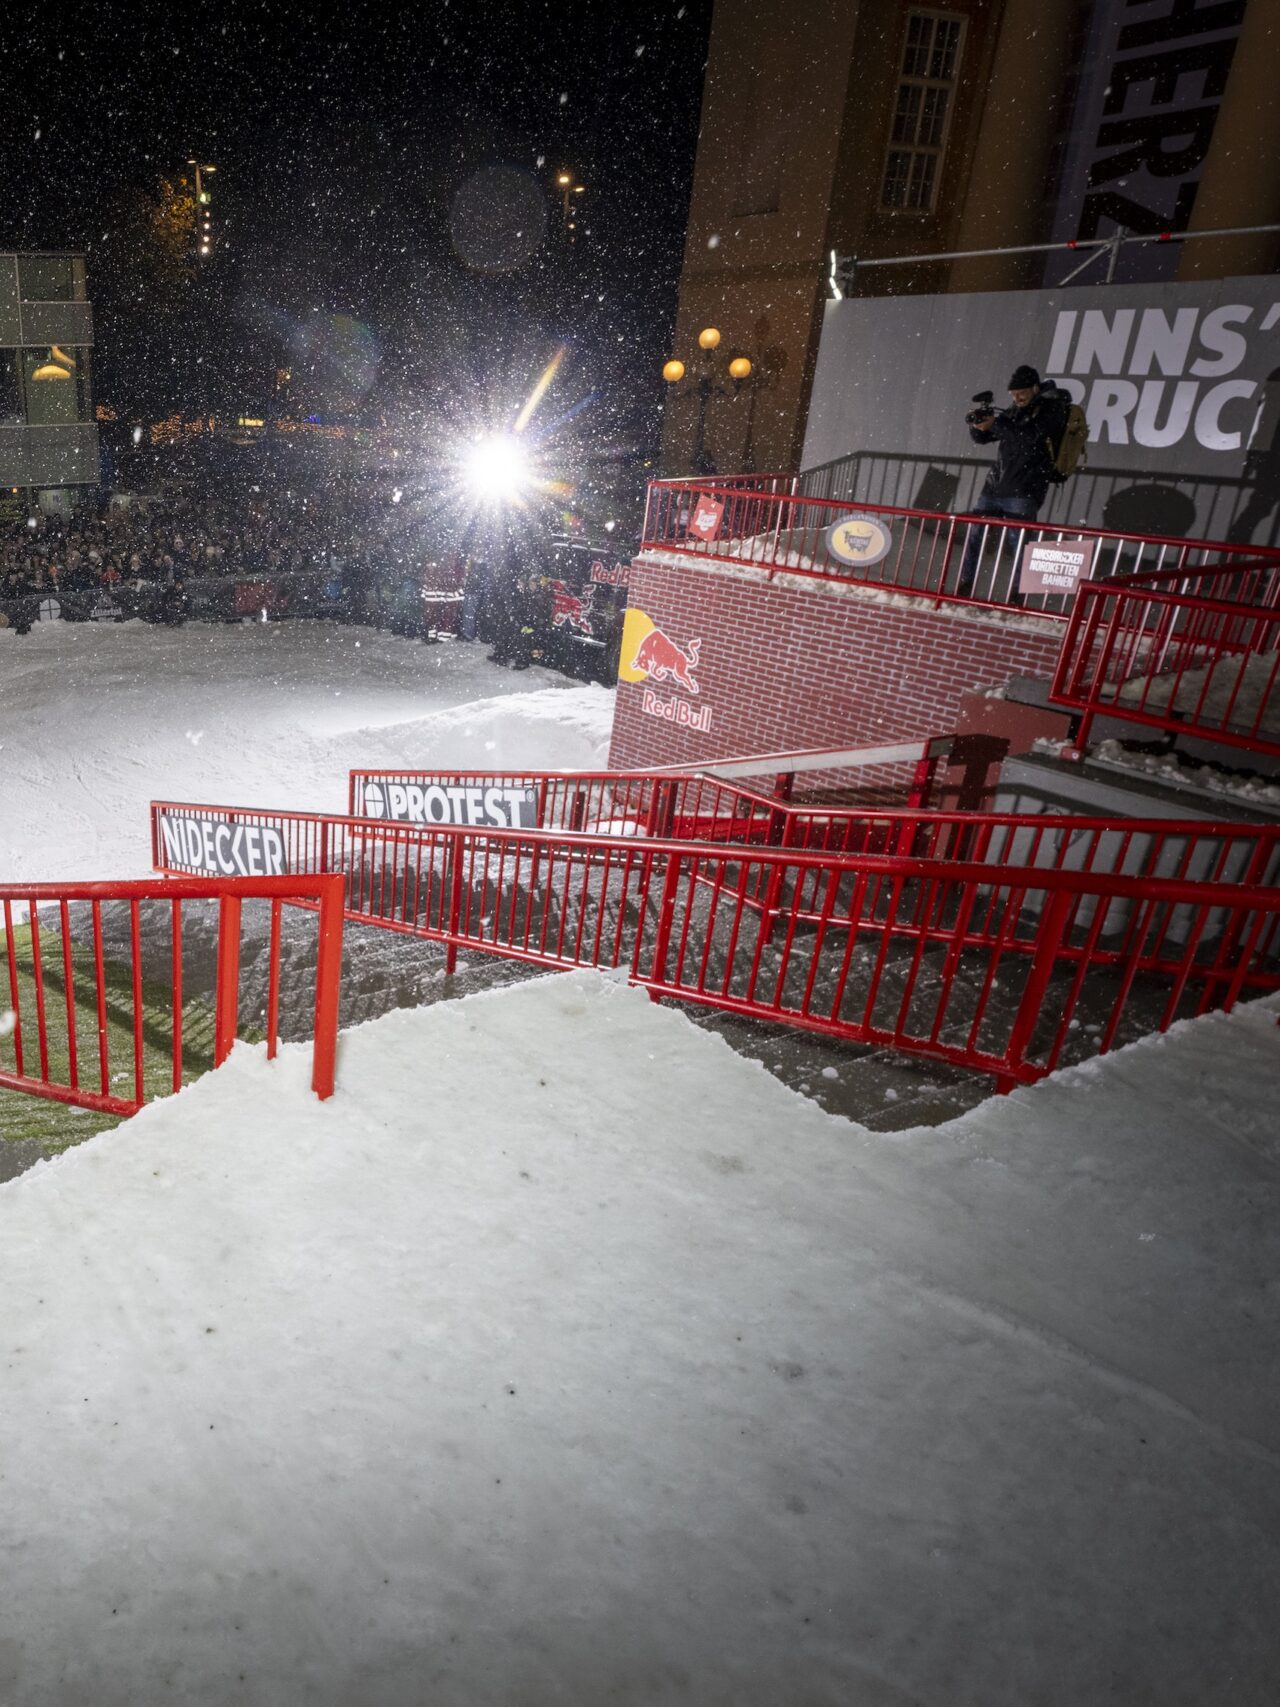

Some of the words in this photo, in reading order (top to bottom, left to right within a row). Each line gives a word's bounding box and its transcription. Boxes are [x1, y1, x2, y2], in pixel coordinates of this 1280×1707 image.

[1043, 378, 1278, 451] RUC
[591, 561, 621, 586] Red
[1029, 560, 1080, 576] NORDKETTEN
[1032, 548, 1084, 565] INNSBRUCKER
[1041, 573, 1074, 588] BAHNEN
[642, 689, 677, 721] Red
[677, 700, 712, 733] Bull
[388, 785, 526, 829] PROTEST
[161, 816, 283, 876] NIDECKER
